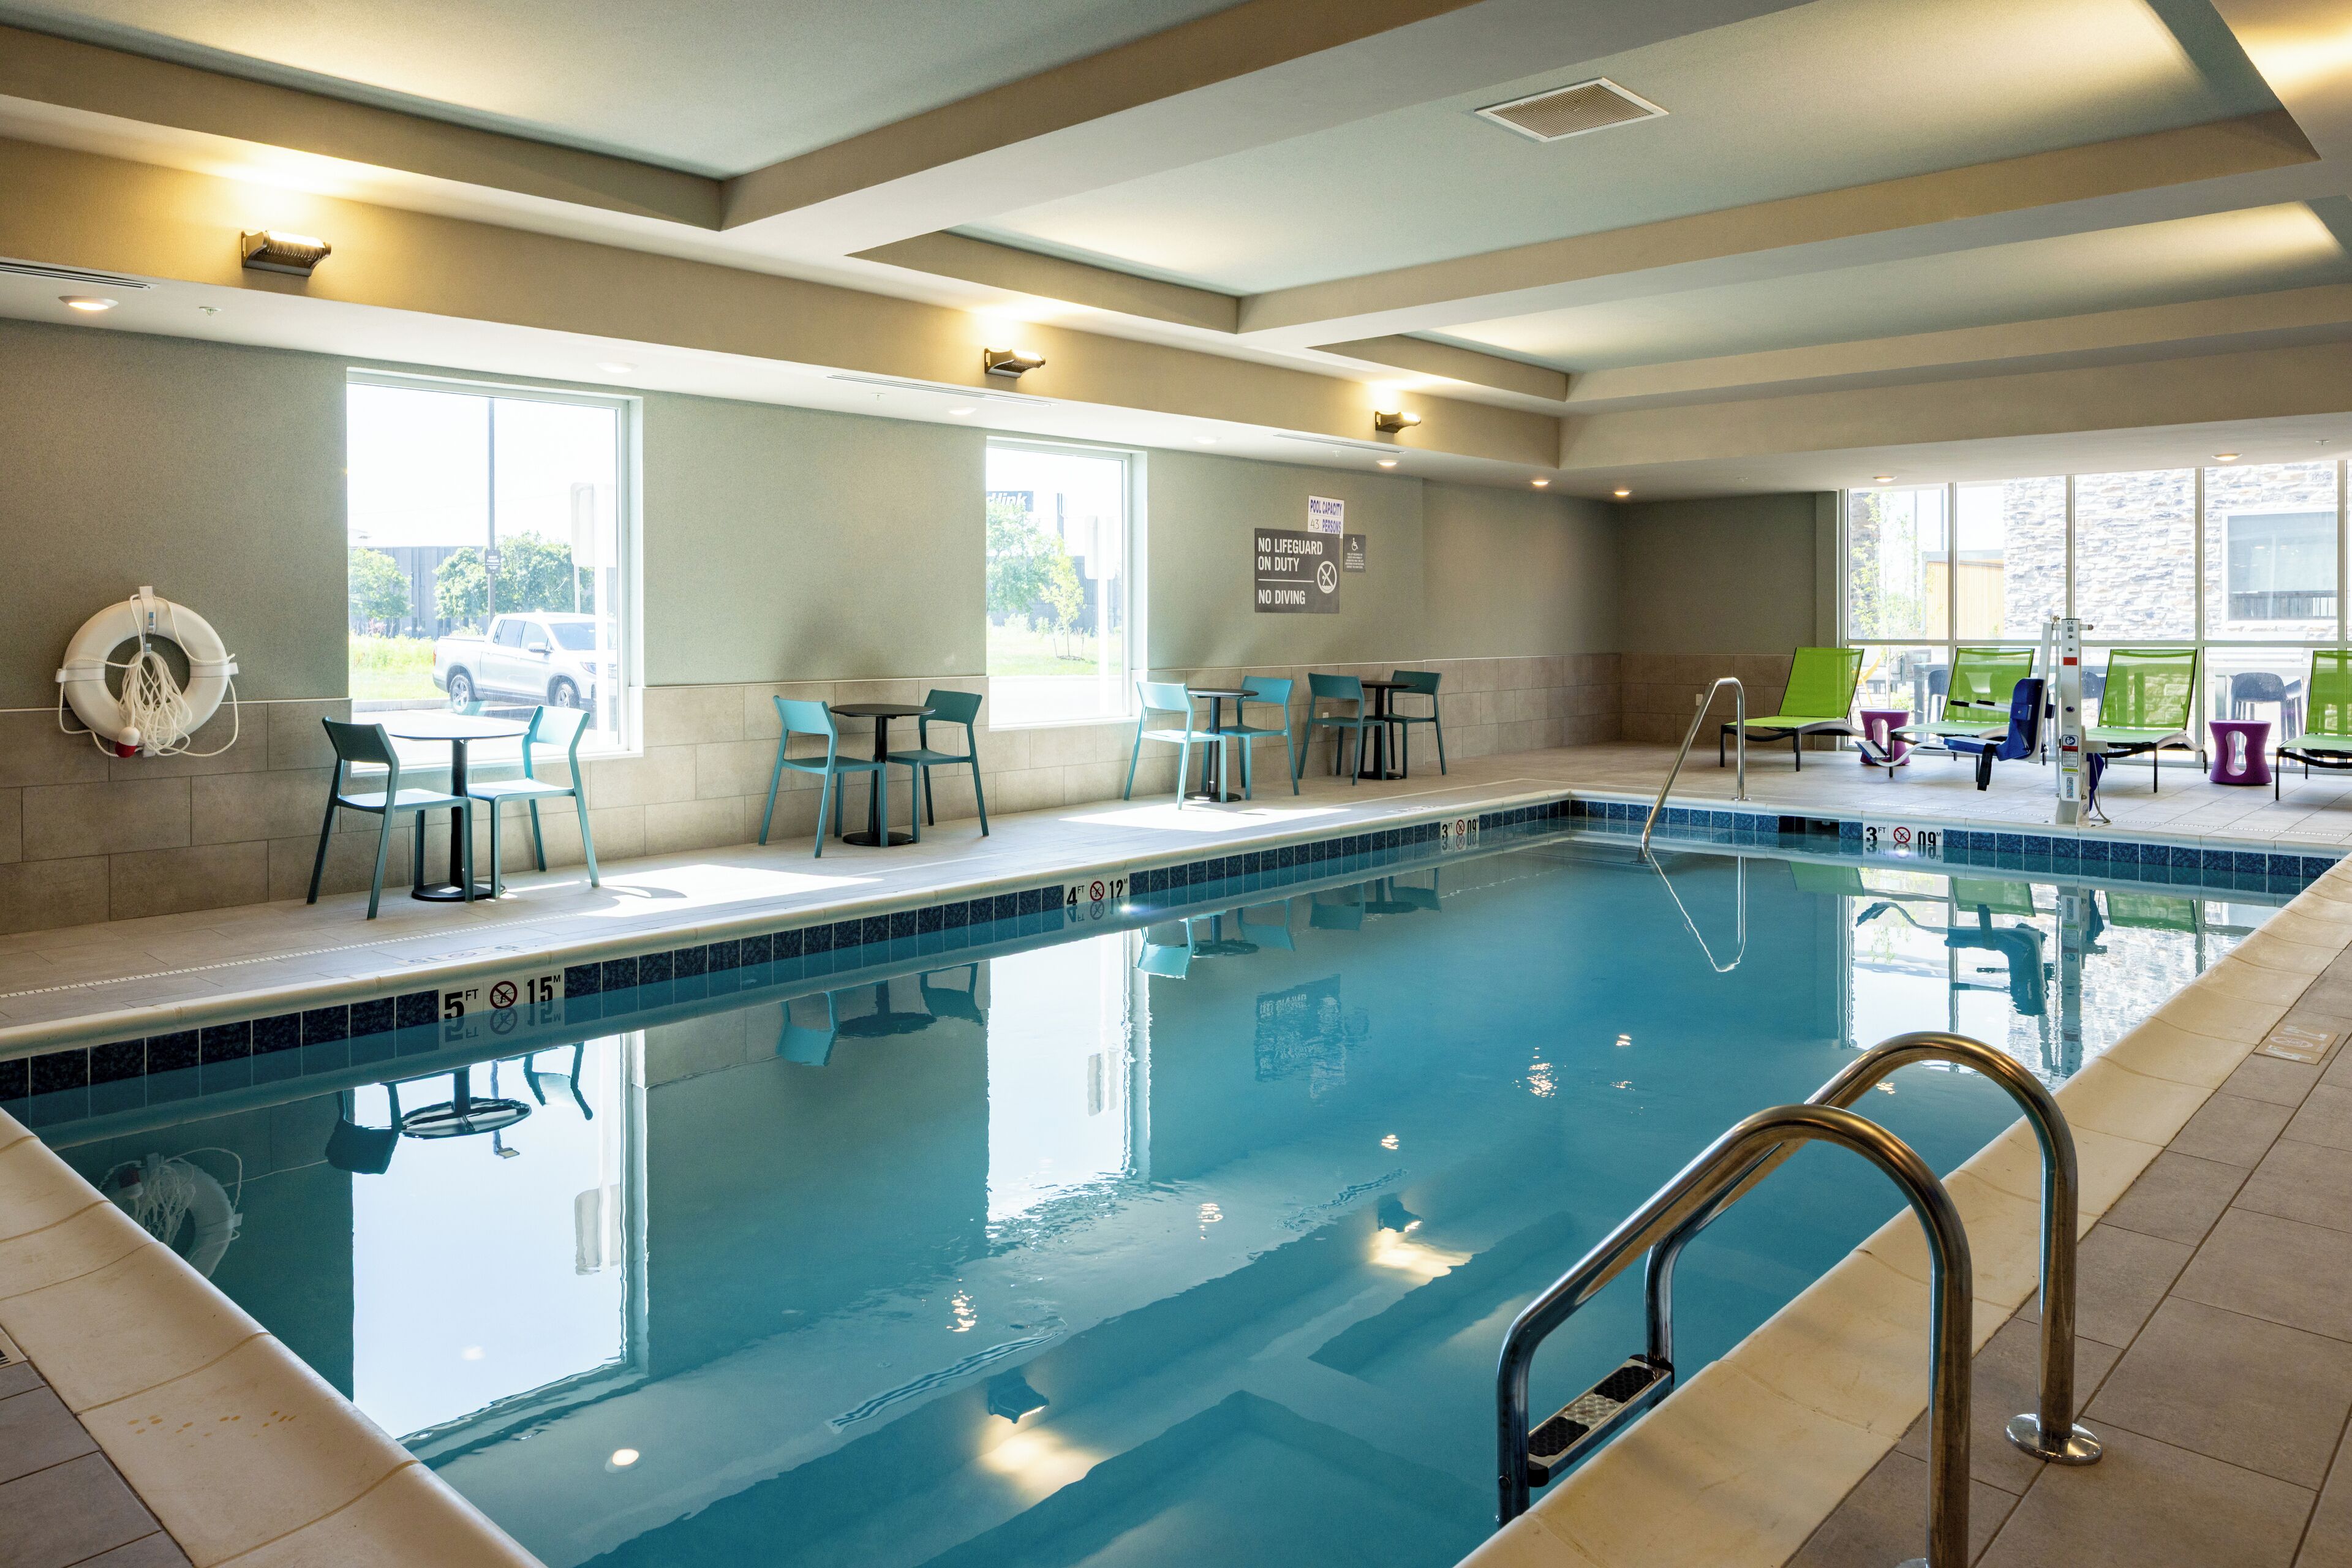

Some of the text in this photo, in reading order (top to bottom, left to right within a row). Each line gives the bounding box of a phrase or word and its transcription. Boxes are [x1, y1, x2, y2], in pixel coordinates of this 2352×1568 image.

[1310, 499, 1342, 516] POOL CAPACITY
[1310, 519, 1341, 535] 43 PERSONS
[1258, 537, 1323, 555] NO LIFEGUARD
[1258, 556, 1300, 572] ON DUTY
[1258, 589, 1305, 605] NO DIVING
[1442, 824, 1448, 838] 3
[1866, 826, 1877, 841] 3
[1066, 886, 1077, 906] 4
[1077, 885, 1085, 894] FT
[444, 991, 464, 1019] 5
[466, 989, 478, 1001] FT
[554, 974, 560, 983] M
